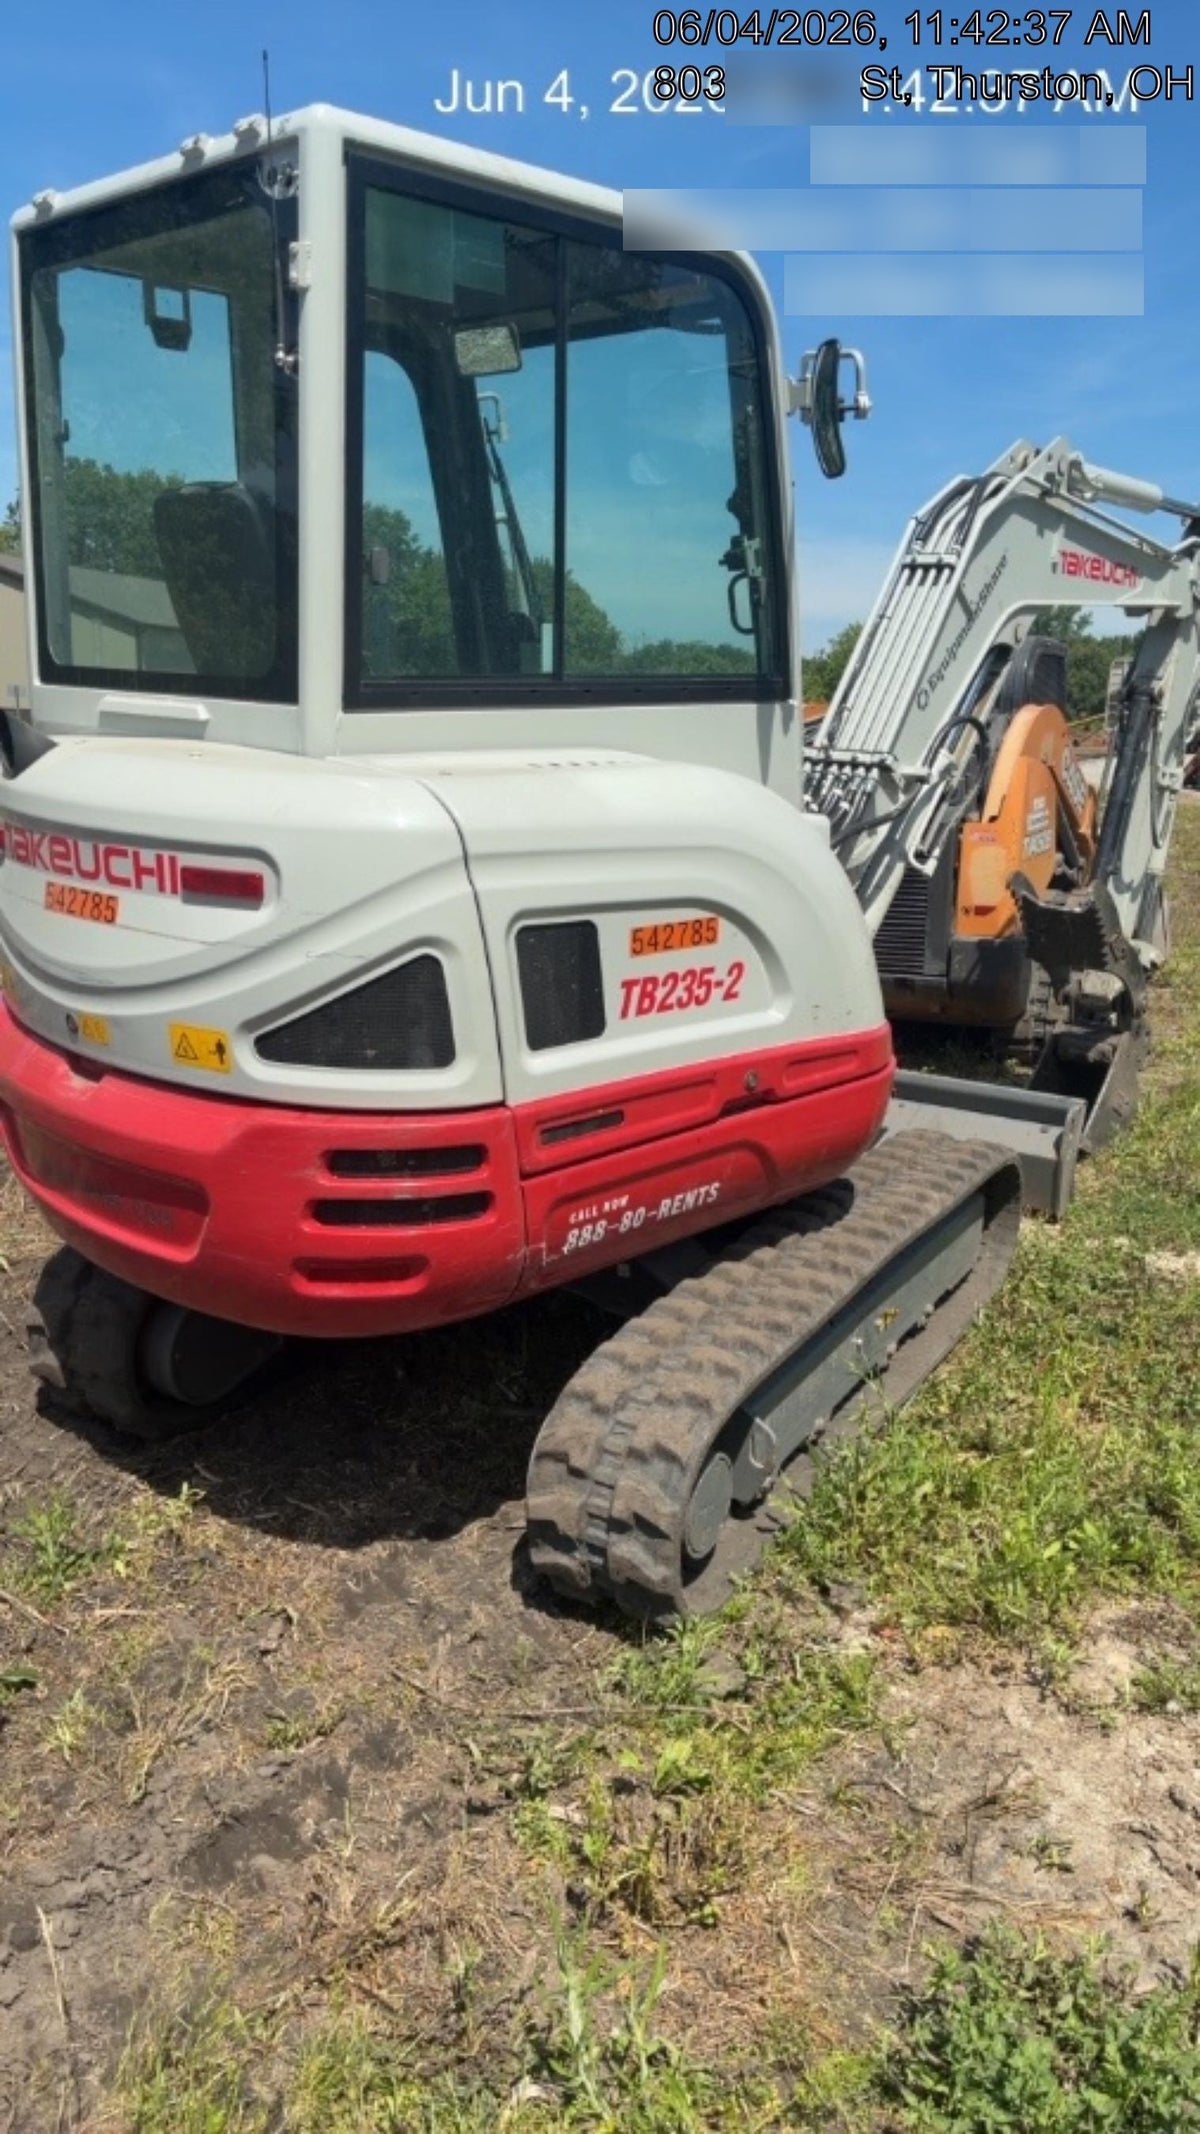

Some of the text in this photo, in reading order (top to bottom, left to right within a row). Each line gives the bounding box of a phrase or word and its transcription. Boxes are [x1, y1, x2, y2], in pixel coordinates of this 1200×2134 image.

[47, 882, 118, 923] 542785
[632, 917, 718, 956] 542785
[620, 961, 744, 1020] TB235-2
[565, 1182, 721, 1252] 888-80-RENTS
[569, 1195, 629, 1224] CALL NOW
